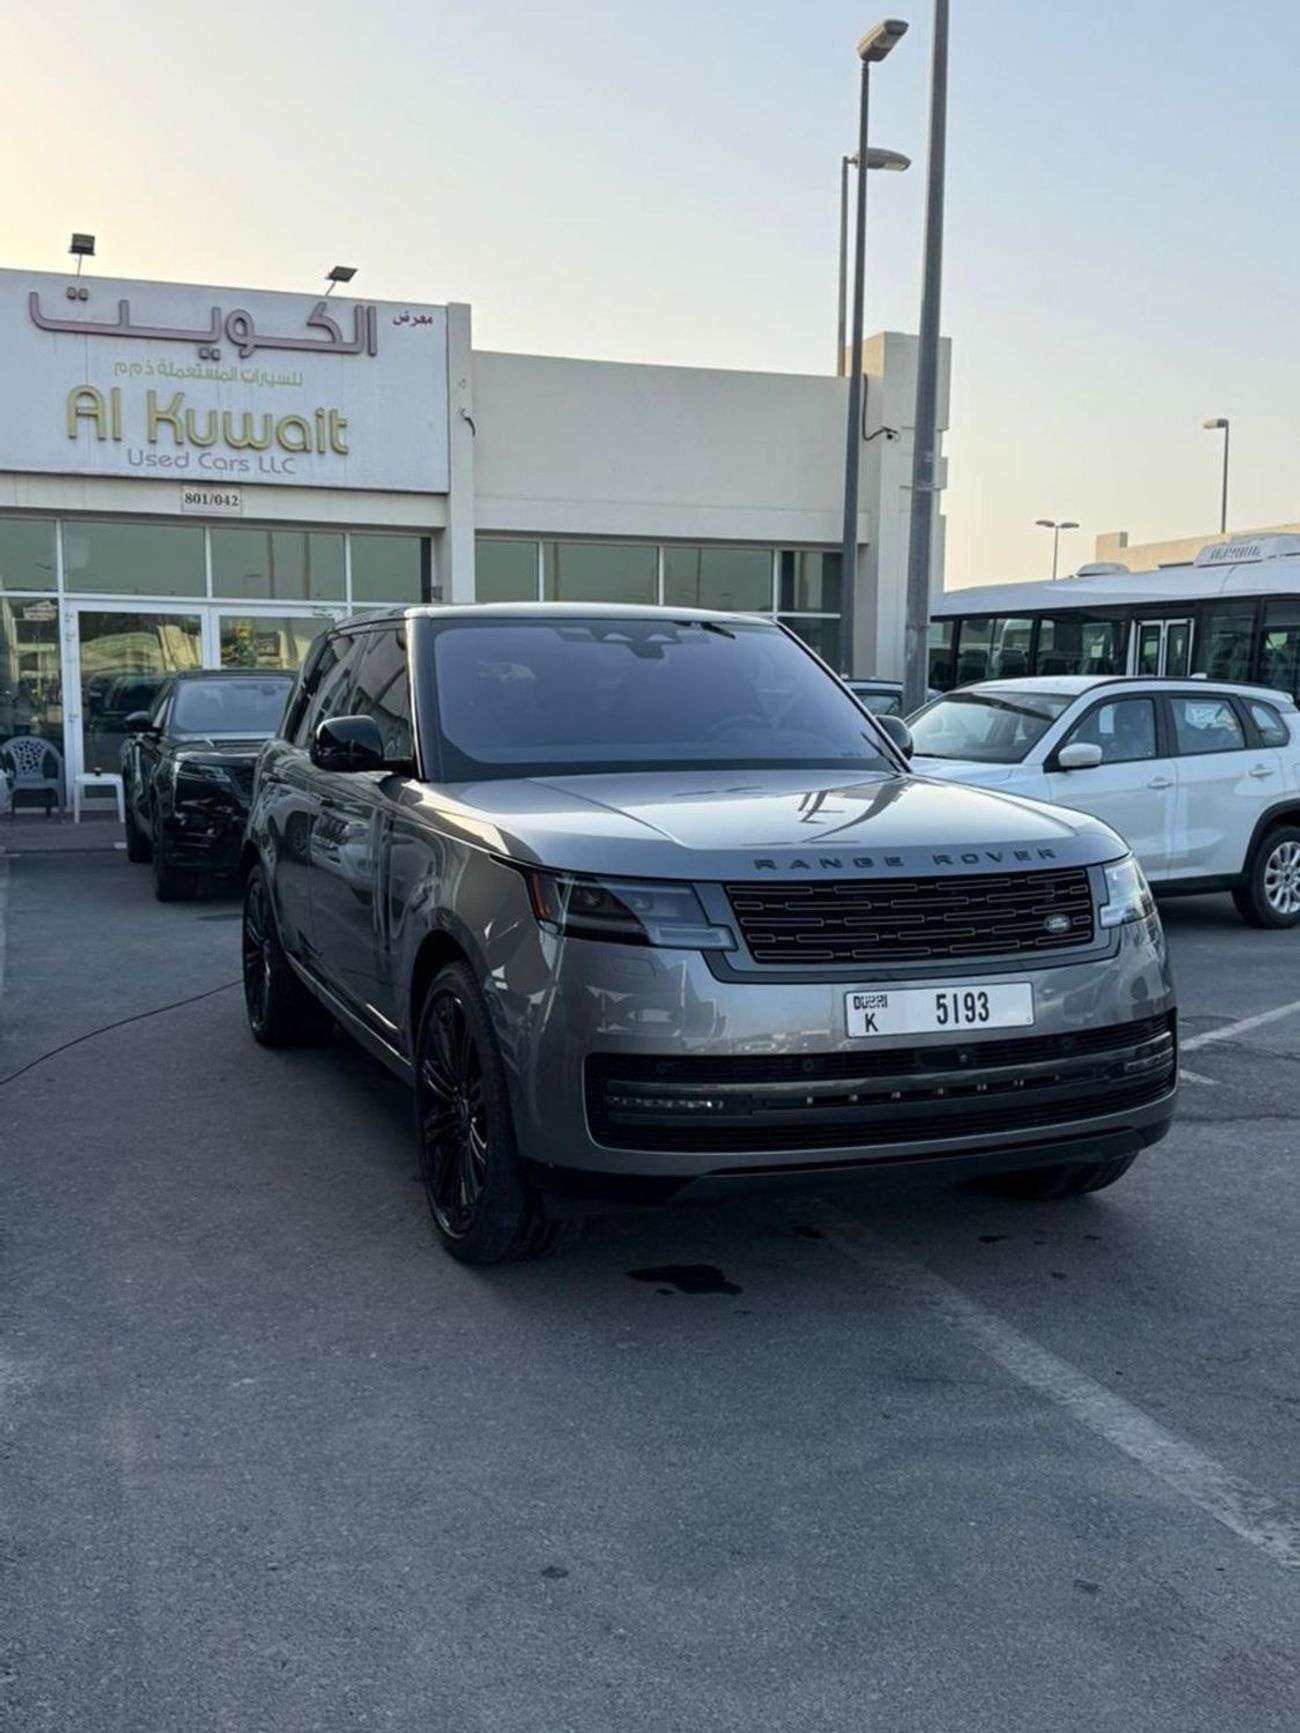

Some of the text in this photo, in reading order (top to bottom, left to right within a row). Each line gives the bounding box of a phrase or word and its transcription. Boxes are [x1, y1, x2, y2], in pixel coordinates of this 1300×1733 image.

[28, 286, 378, 361] الكويت
[392, 309, 434, 328] معرض
[156, 361, 238, 383] المستعملة
[240, 371, 304, 388] للسيارات
[66, 384, 350, 455] Al Kuwait
[127, 448, 298, 475] Used Cars LLC
[184, 492, 240, 508] 801/042
[753, 848, 1057, 871] RANGE ROVER
[935, 991, 990, 1025] 5193
[864, 1012, 879, 1033] K
